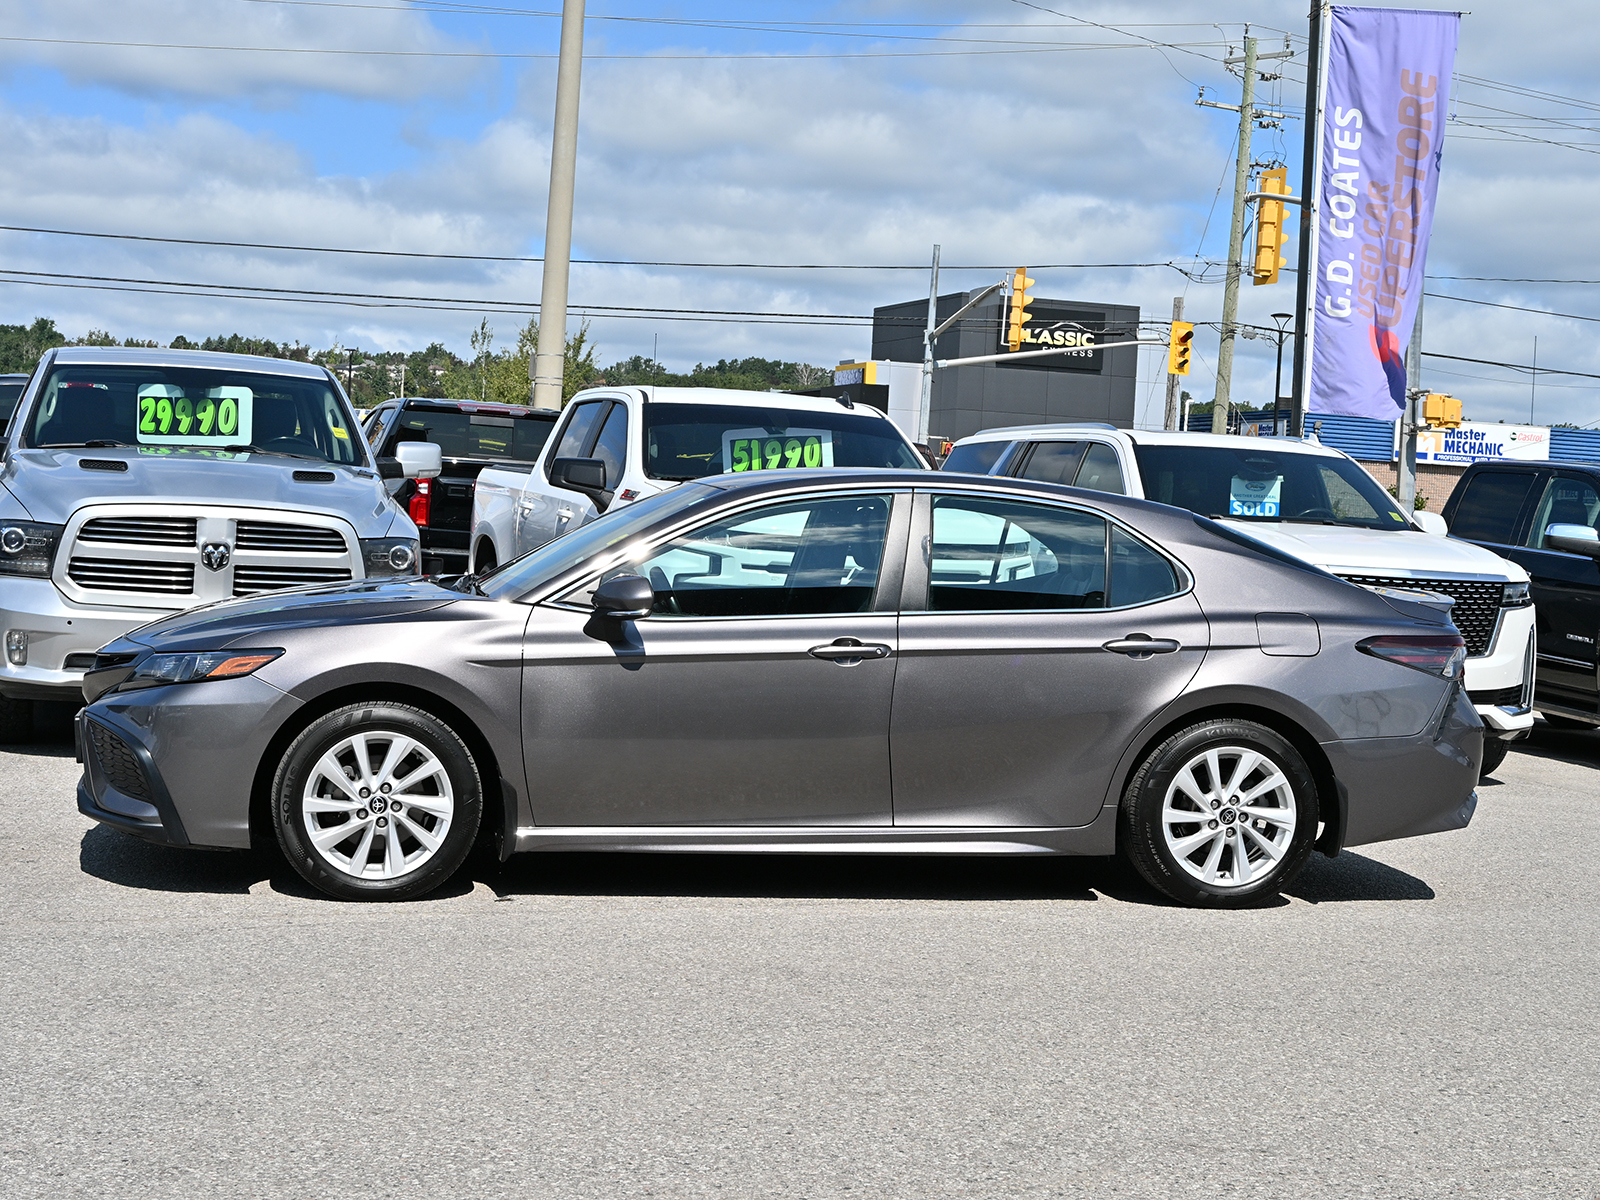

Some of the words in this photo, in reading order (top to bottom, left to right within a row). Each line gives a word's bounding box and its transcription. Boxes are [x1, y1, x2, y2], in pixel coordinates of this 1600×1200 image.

[1329, 105, 1363, 239] COATES
[1363, 180, 1390, 238] CAR
[1324, 252, 1355, 318] G.D.
[1356, 243, 1382, 319] USED
[1019, 328, 1095, 347] LASSIC
[140, 397, 238, 435] 29990
[1444, 427, 1486, 441] Master
[1517, 432, 1543, 442] Castrol
[732, 436, 822, 472] 51990
[1444, 440, 1504, 456] MECHANIC
[1232, 501, 1276, 517] SOLD
[1205, 728, 1260, 740] KUMHO
